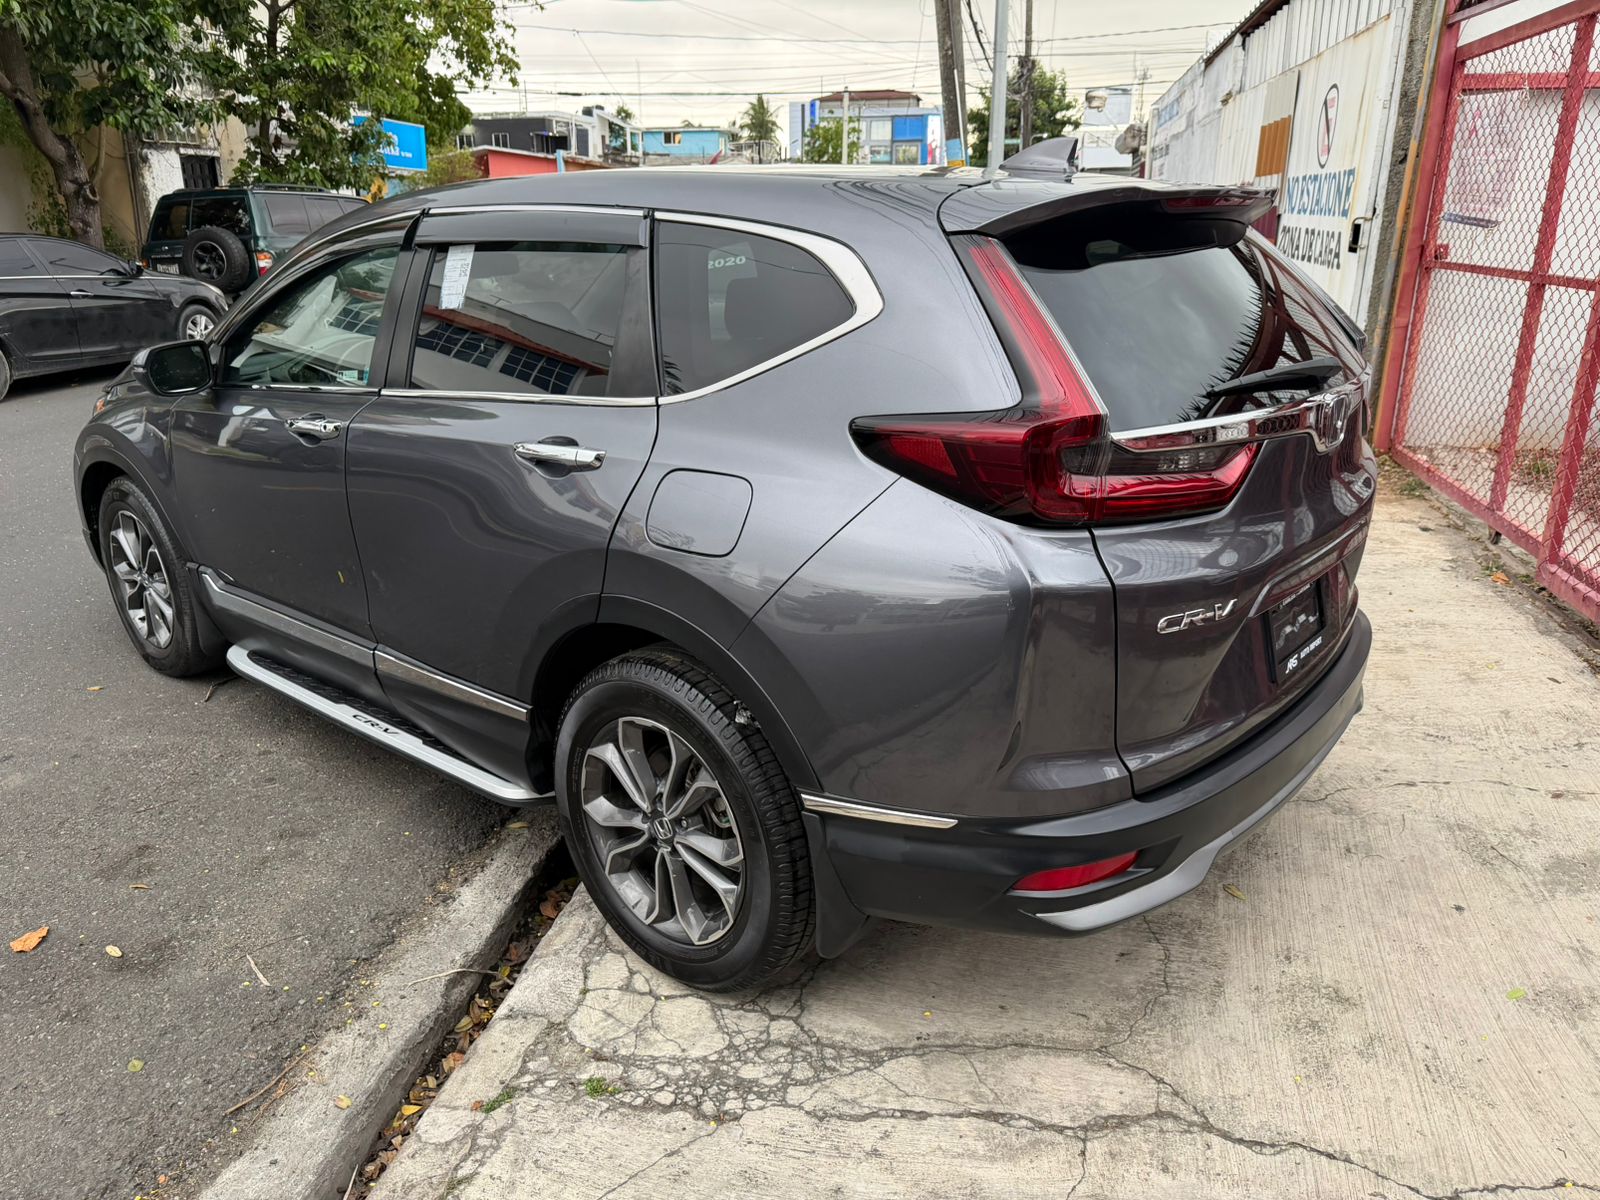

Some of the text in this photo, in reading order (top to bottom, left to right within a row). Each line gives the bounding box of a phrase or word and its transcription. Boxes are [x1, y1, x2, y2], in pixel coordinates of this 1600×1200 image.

[1284, 168, 1356, 219] NO ESTACIONE
[708, 255, 746, 269] 2020
[1278, 225, 1342, 270] ZONA DE CARGA
[1156, 598, 1238, 634] CR-V
[352, 714, 400, 735] CR-V
